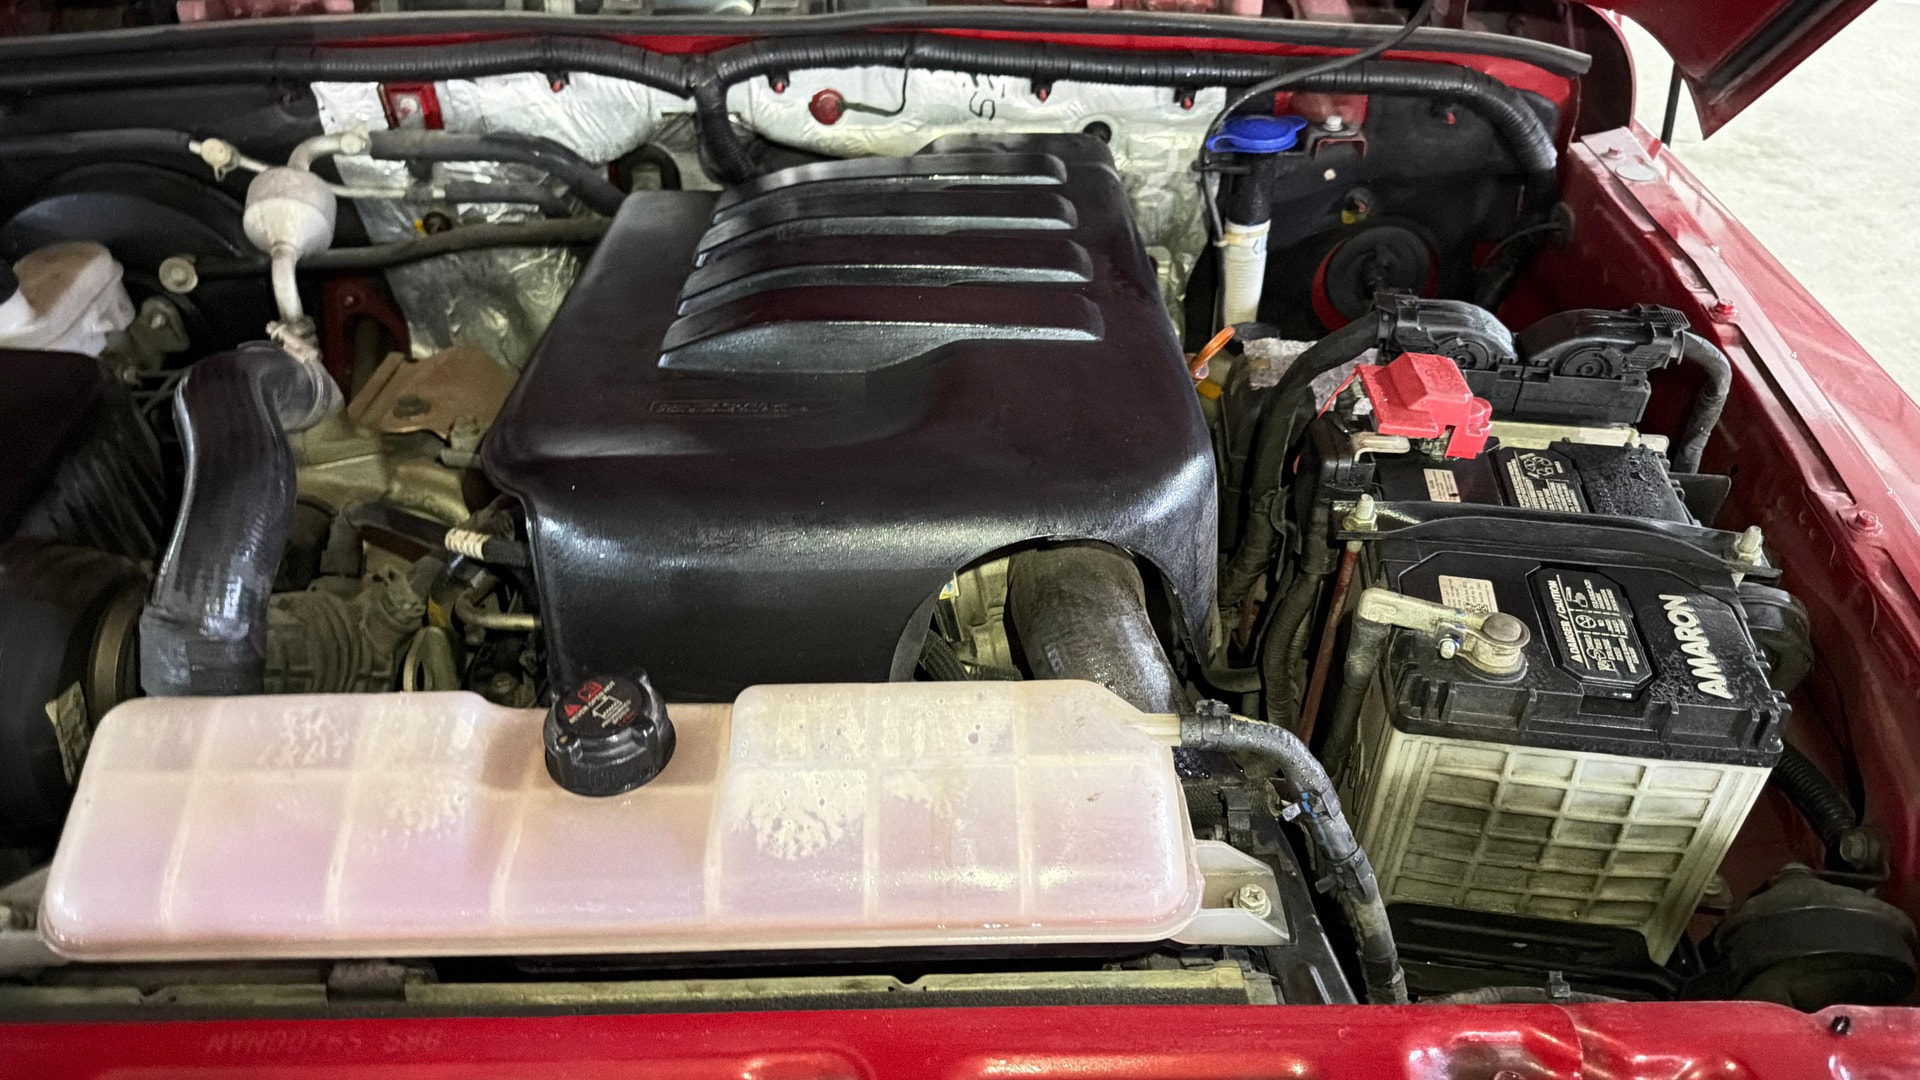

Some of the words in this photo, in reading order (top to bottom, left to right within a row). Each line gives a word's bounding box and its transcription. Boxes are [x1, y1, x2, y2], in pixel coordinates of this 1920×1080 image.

[1547, 579, 1567, 614] CAUTION
[1560, 620, 1581, 655] DANGER
[1658, 594, 1734, 699] AMARON
